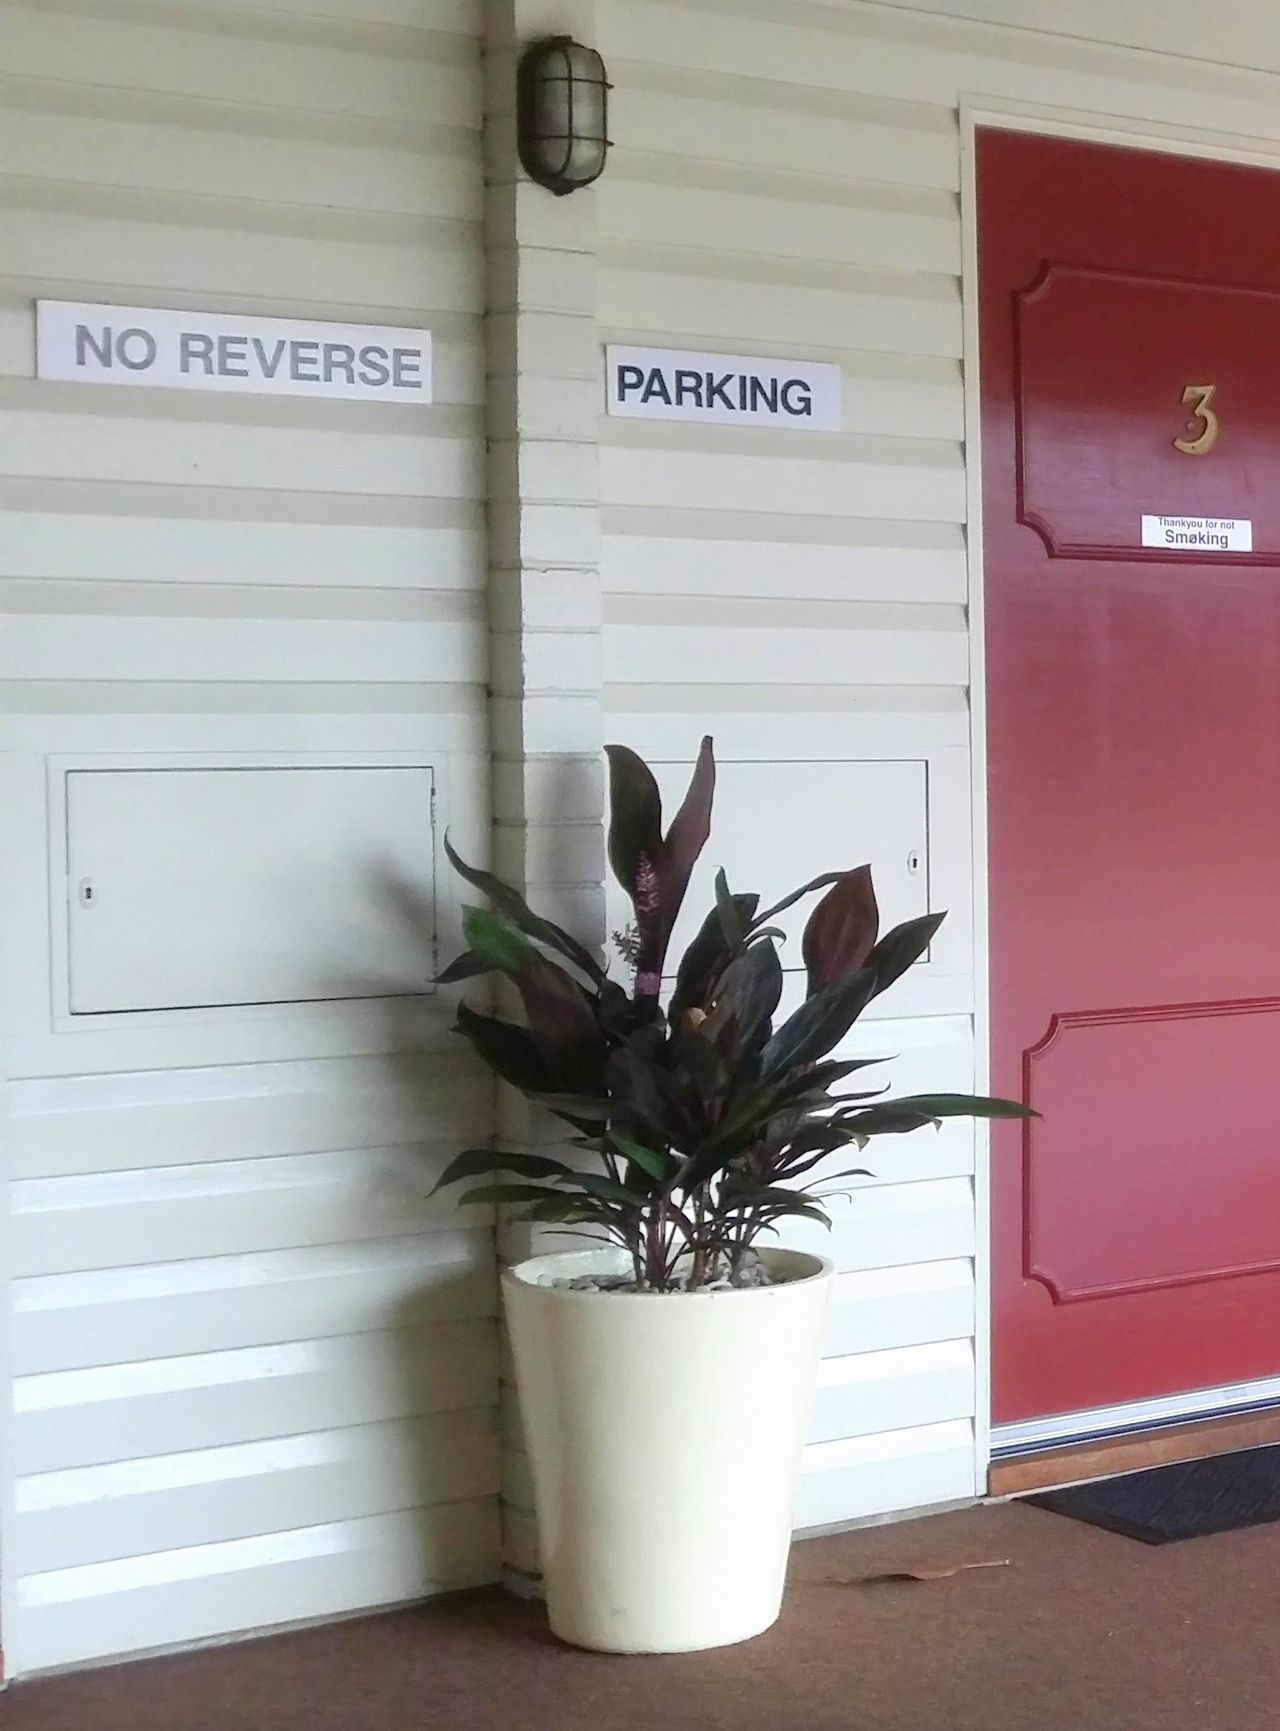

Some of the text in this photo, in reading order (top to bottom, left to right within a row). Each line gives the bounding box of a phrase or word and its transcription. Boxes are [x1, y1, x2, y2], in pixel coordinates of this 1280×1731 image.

[75, 324, 423, 389] NO REVERSE
[617, 364, 812, 417] PARKING
[1172, 384, 1219, 456] 3
[1158, 517, 1235, 530] Thankyou for not
